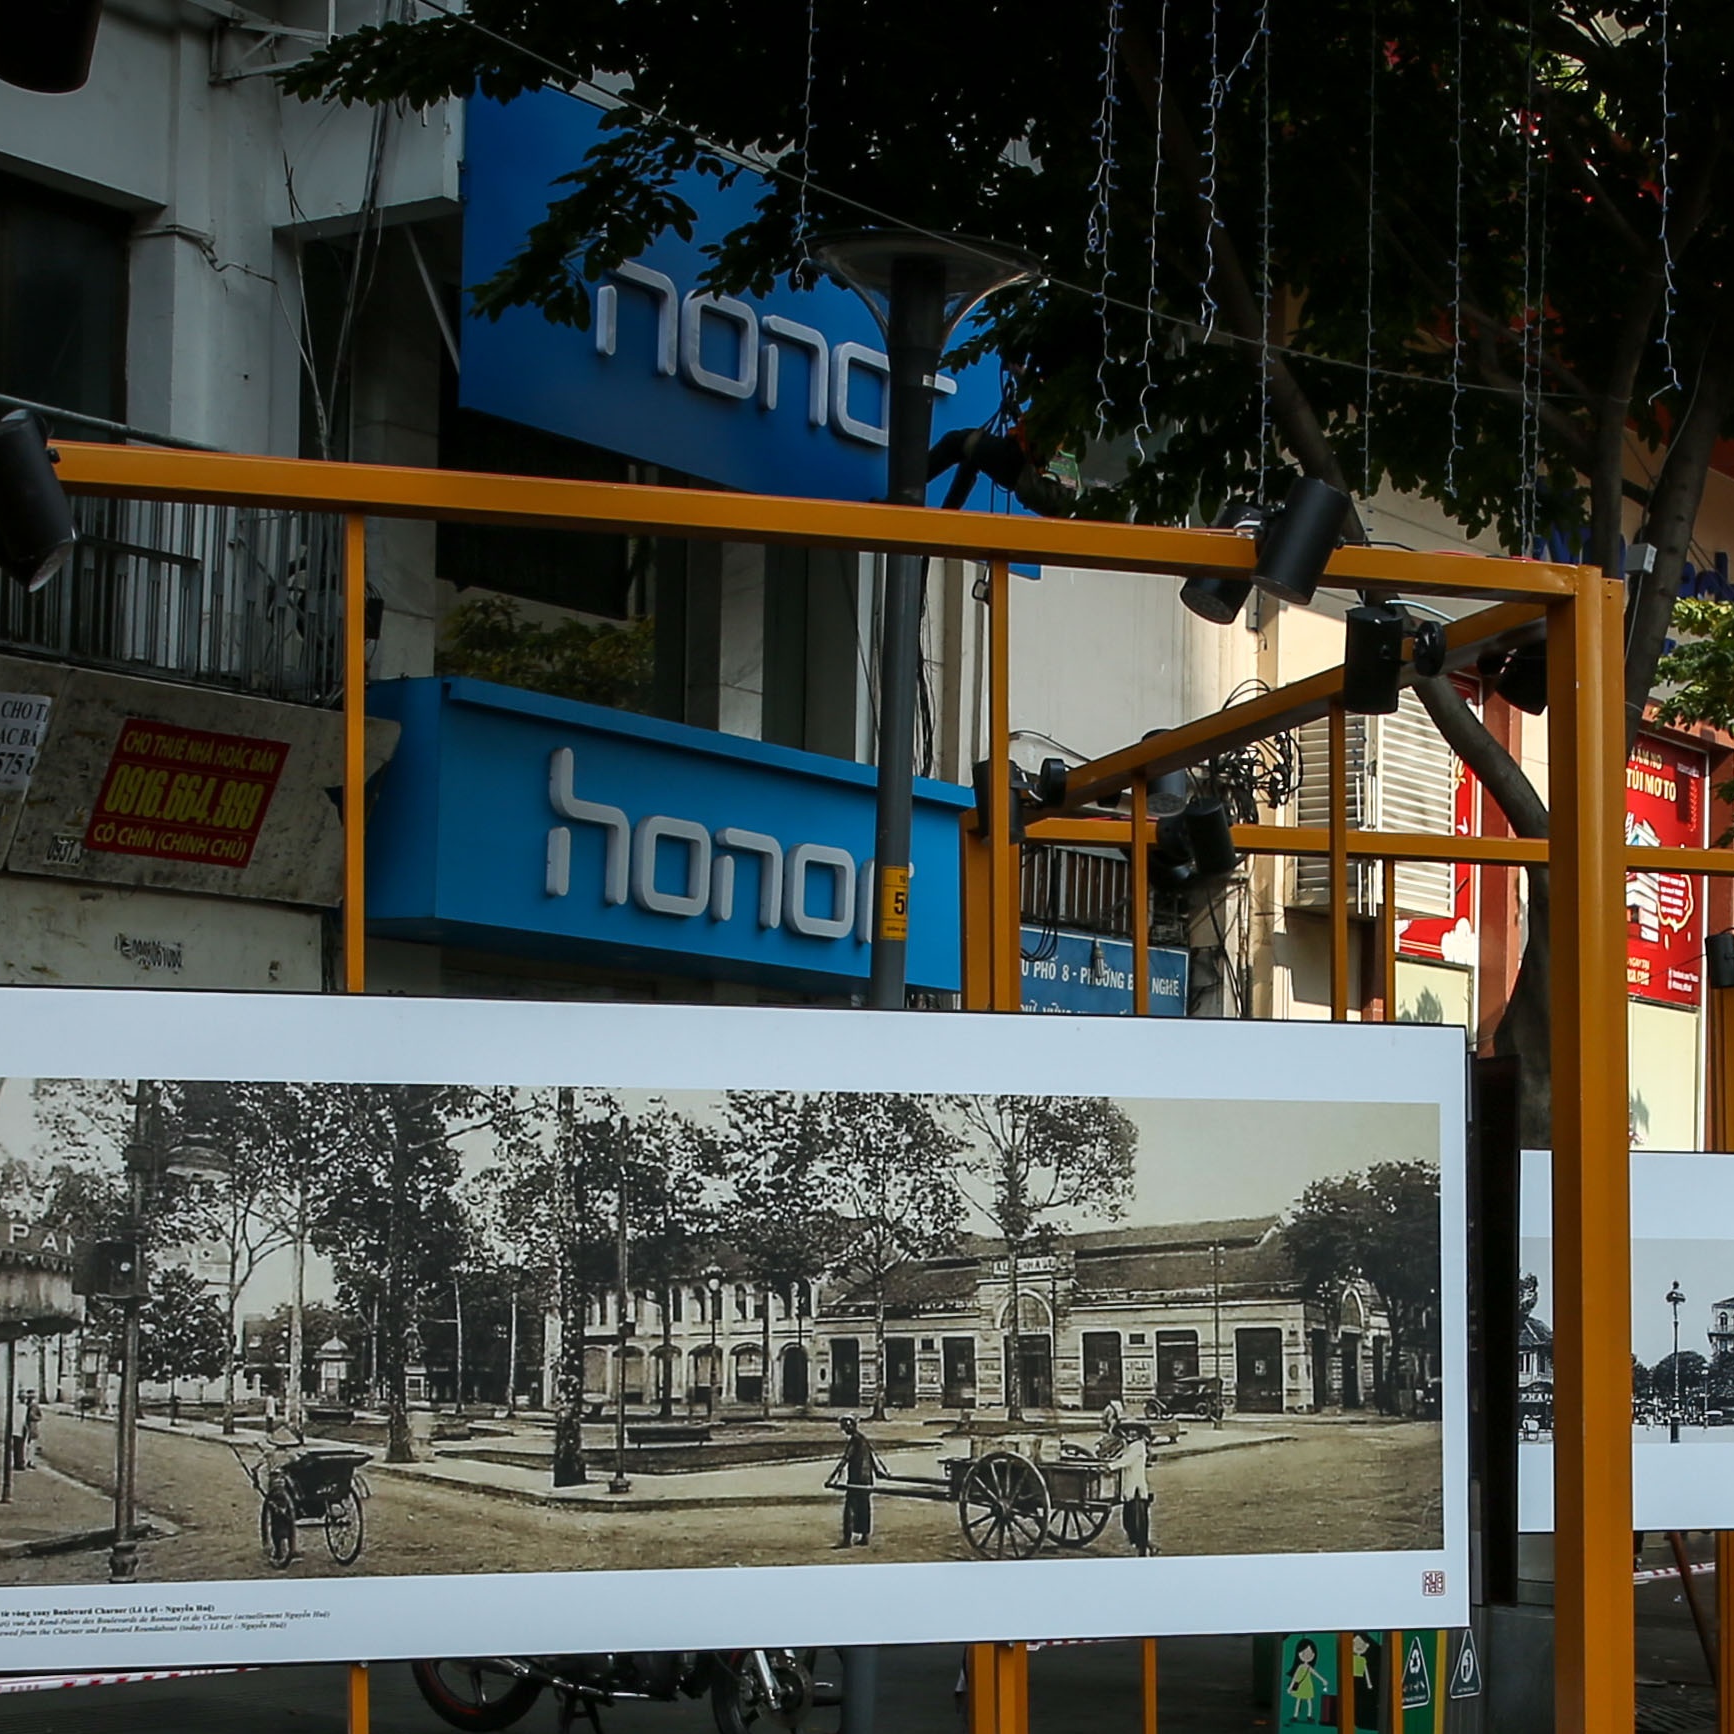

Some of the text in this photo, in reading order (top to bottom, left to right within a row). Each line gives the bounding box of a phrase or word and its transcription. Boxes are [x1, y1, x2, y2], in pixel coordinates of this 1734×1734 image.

[596, 259, 957, 447] hono
[1, 700, 33, 721] CHO
[122, 729, 153, 756] CHO
[152, 733, 188, 760] THUÊ
[184, 735, 216, 764] NHÀ
[249, 745, 280, 776] BÁN
[103, 763, 266, 831] 0916.664.999
[1664, 780, 1677, 802] TO
[93, 821, 116, 844] CÔ
[117, 823, 156, 849] CHÍN
[155, 829, 210, 853] (CHÍNH
[1033, 955, 1058, 981] PHỐ
[1061, 964, 1070, 982] 8
